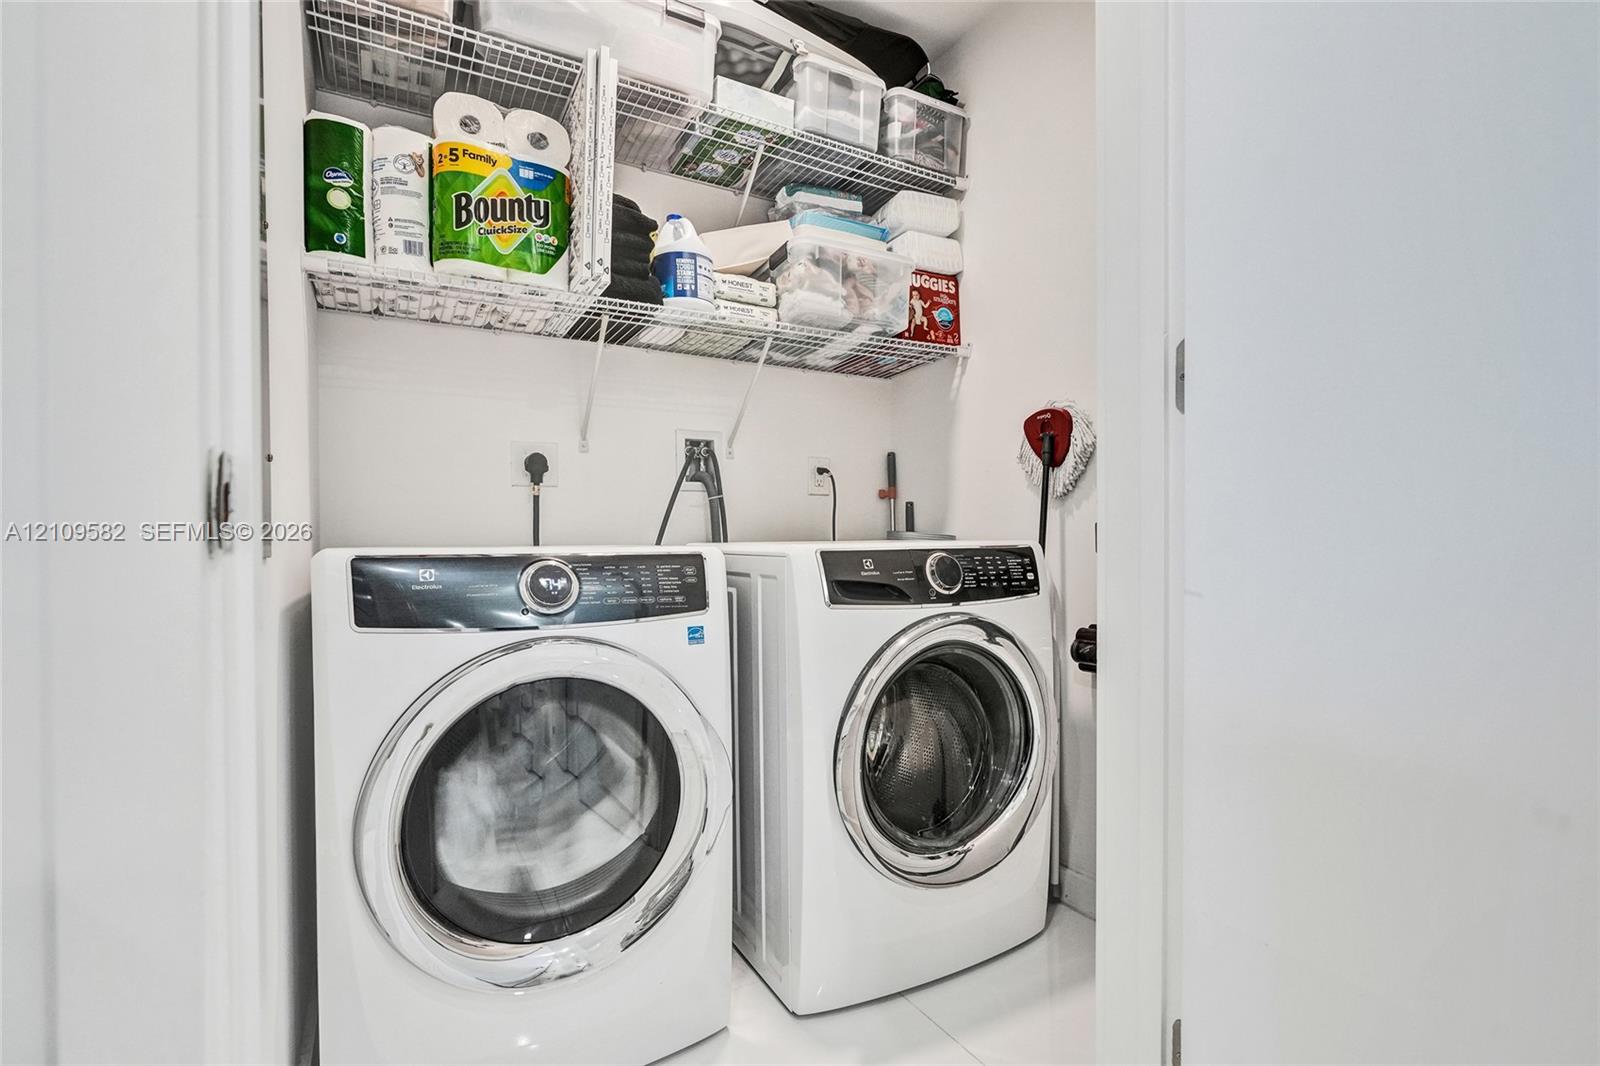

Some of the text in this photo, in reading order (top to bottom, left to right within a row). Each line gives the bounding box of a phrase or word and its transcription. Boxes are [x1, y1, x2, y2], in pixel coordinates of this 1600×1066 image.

[462, 148, 498, 168] Family
[454, 193, 550, 230] Bounty
[478, 225, 528, 236] QuickSize
[727, 279, 753, 289] HONEST
[911, 273, 956, 294] UGGIES
